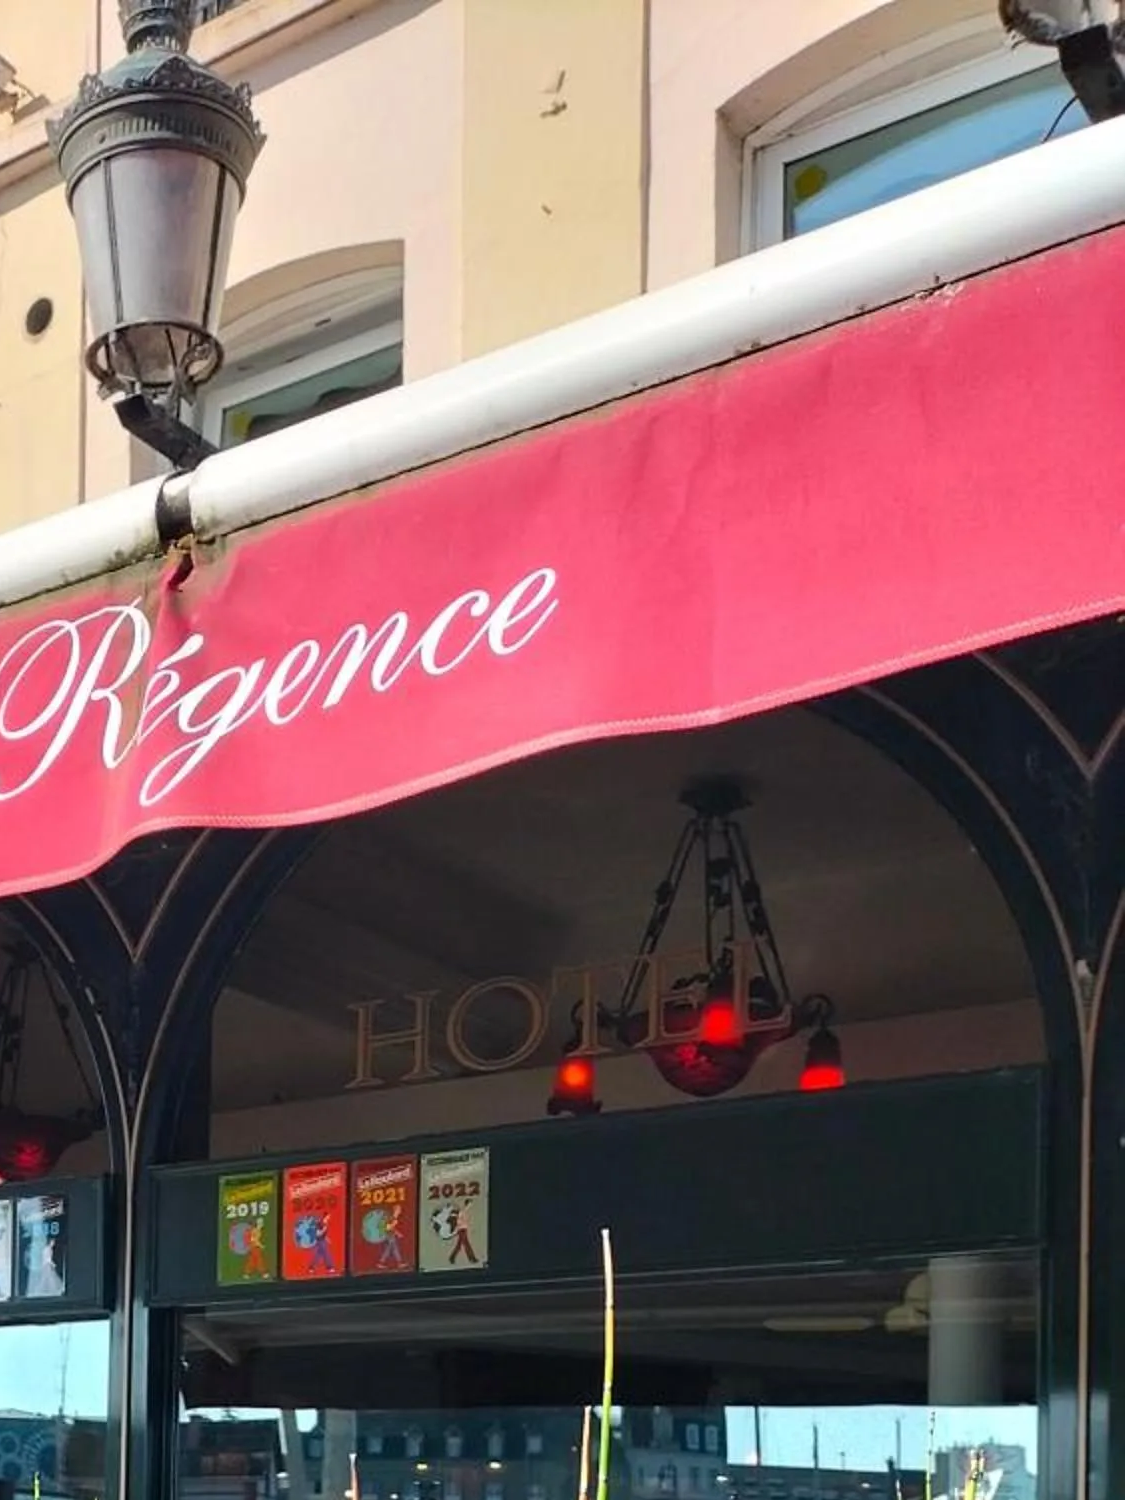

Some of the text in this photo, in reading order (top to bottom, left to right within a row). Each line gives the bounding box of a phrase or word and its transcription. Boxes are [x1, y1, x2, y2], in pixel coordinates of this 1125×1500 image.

[343, 939, 793, 1090] HOTEL
[361, 1187, 406, 1205] 2021
[428, 1181, 481, 1200] 2022
[226, 1201, 270, 1219] 2019
